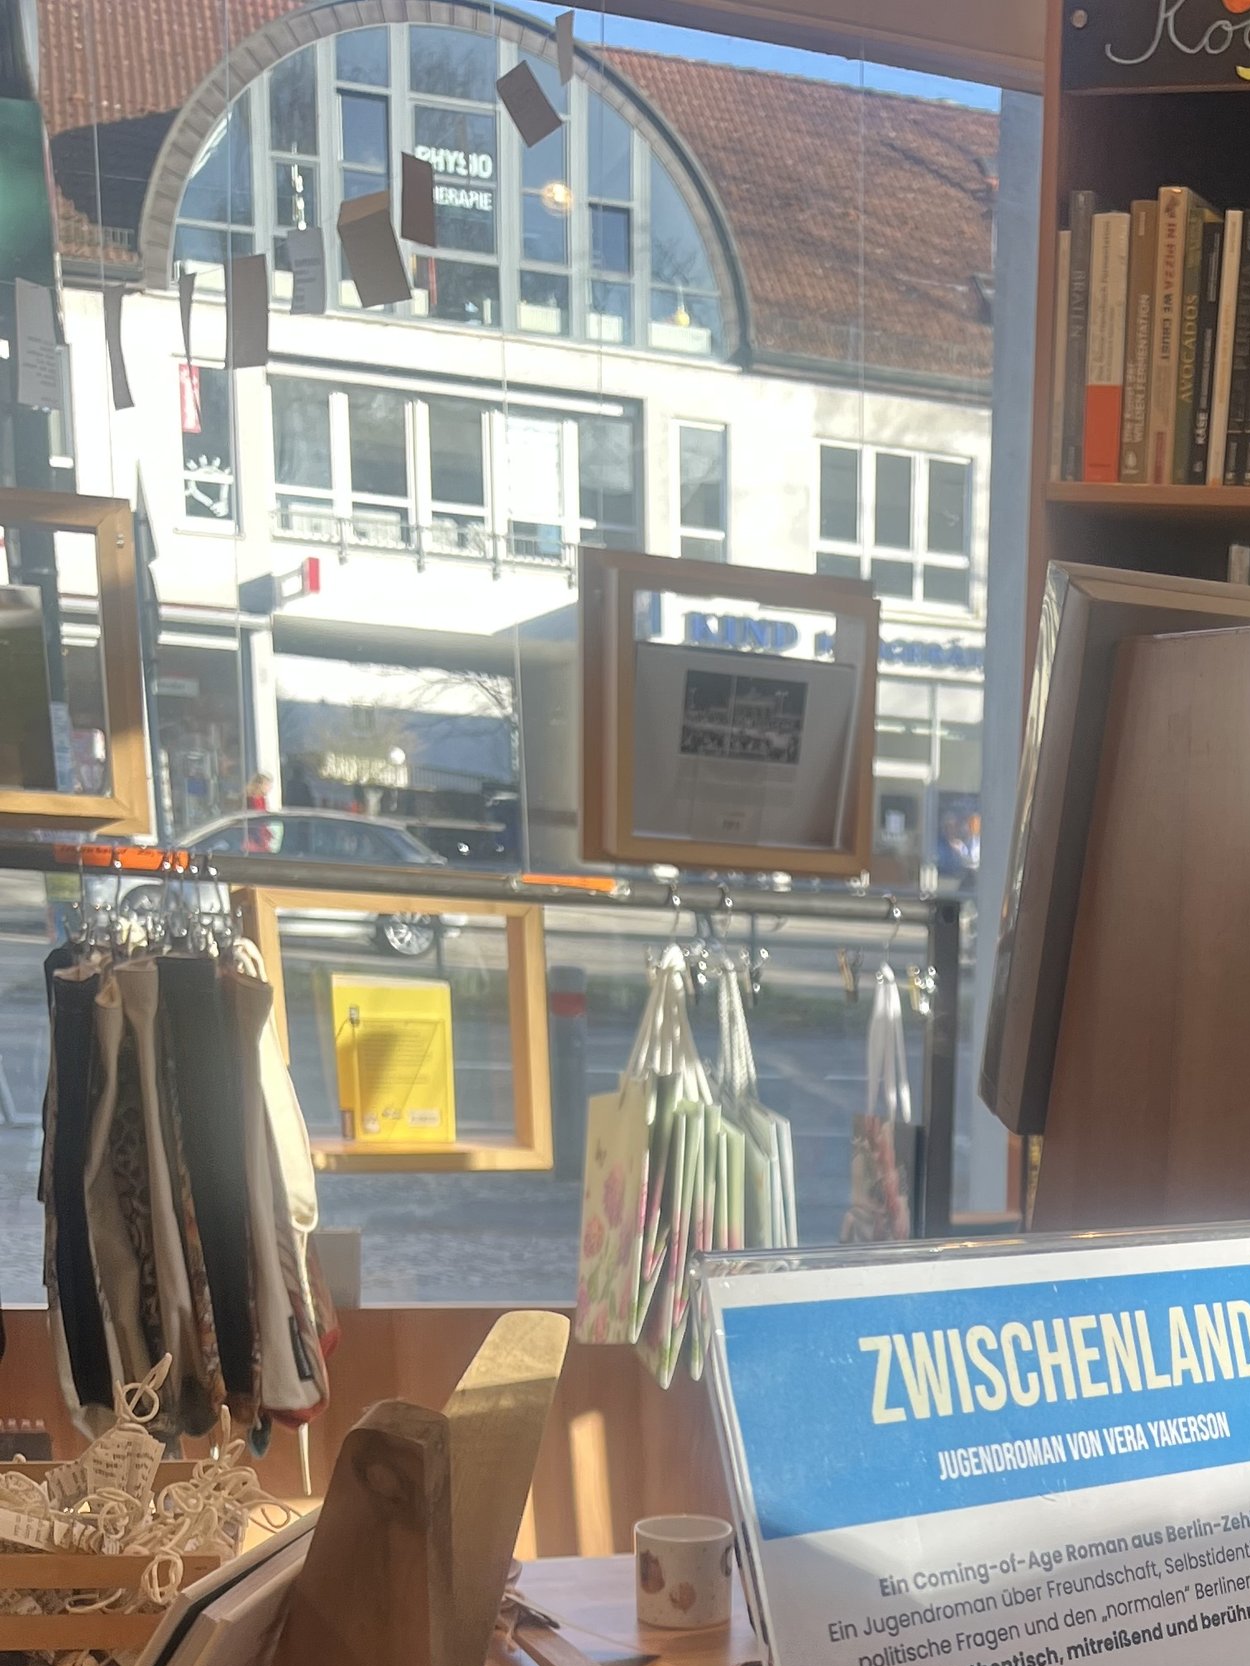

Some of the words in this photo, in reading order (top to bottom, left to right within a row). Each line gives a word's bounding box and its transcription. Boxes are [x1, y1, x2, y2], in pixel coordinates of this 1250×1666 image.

[415, 145, 493, 178] PHYSIO
[433, 186, 493, 211] ERAPIE
[1180, 294, 1198, 403] AVOCADOS
[685, 611, 799, 652] KIND
[937, 1434, 1066, 1481] JUGENDROMAN
[1065, 1429, 1104, 1460] VON
[1102, 1423, 1149, 1455] VERA
[1147, 1411, 1231, 1448] YAKERSON
[878, 1575, 909, 1597] Ein
[913, 1549, 1063, 1590] Coming-of-Age
[1065, 1537, 1129, 1562] Roman
[1131, 1531, 1164, 1549] aus
[828, 1620, 858, 1643] Ein
[863, 1596, 998, 1637] Jugendroman
[1001, 1586, 1042, 1608] über
[1046, 1560, 1162, 1599] Freundschaft,
[955, 1624, 1021, 1651] Fragen
[1024, 1612, 1060, 1636] und
[1063, 1608, 1097, 1628] den
[1194, 1575, 1250, 1600] Berliner
[1066, 1622, 1164, 1661] mitreißend
[1165, 1614, 1199, 1638] und
